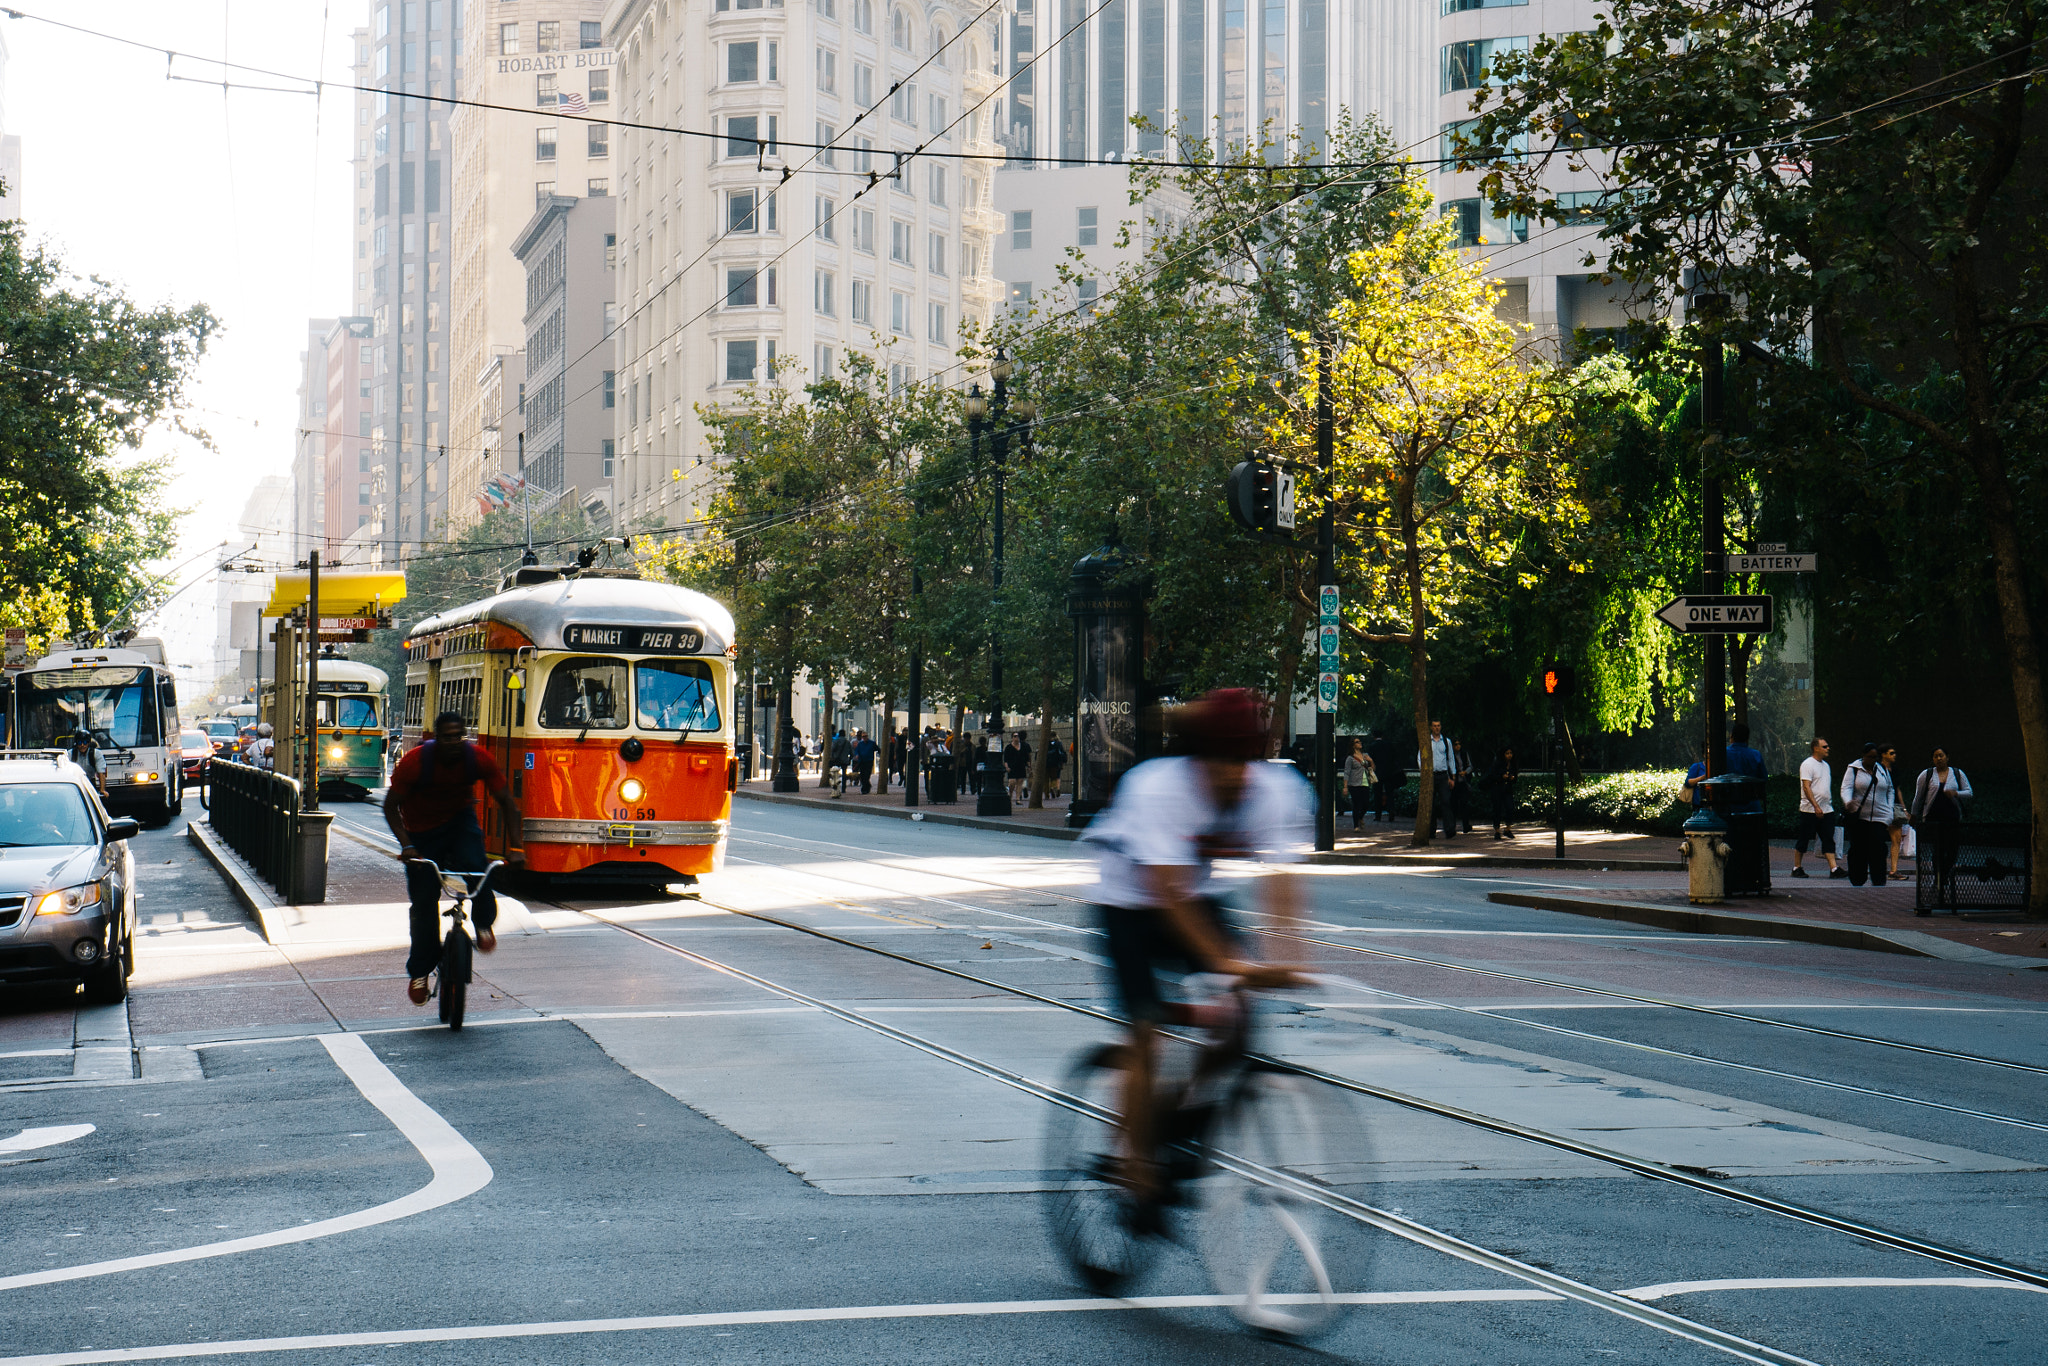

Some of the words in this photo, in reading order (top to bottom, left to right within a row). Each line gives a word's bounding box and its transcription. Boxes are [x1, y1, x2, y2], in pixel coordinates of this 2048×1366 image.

[498, 55, 568, 73] HOBART
[575, 52, 617, 68] BUIL
[1741, 557, 1802, 568] BATTERY
[1325, 604, 1335, 613] 50
[1689, 607, 1721, 621] ONE
[1727, 607, 1760, 621] WAY
[340, 618, 366, 628] RAPID
[320, 633, 344, 642] RAPID
[570, 628, 578, 643] F
[582, 628, 623, 645] MARKET
[640, 632, 674, 648] PIER
[677, 634, 697, 649] 39
[564, 706, 581, 718] 72
[1090, 701, 1131, 714] MUSIC
